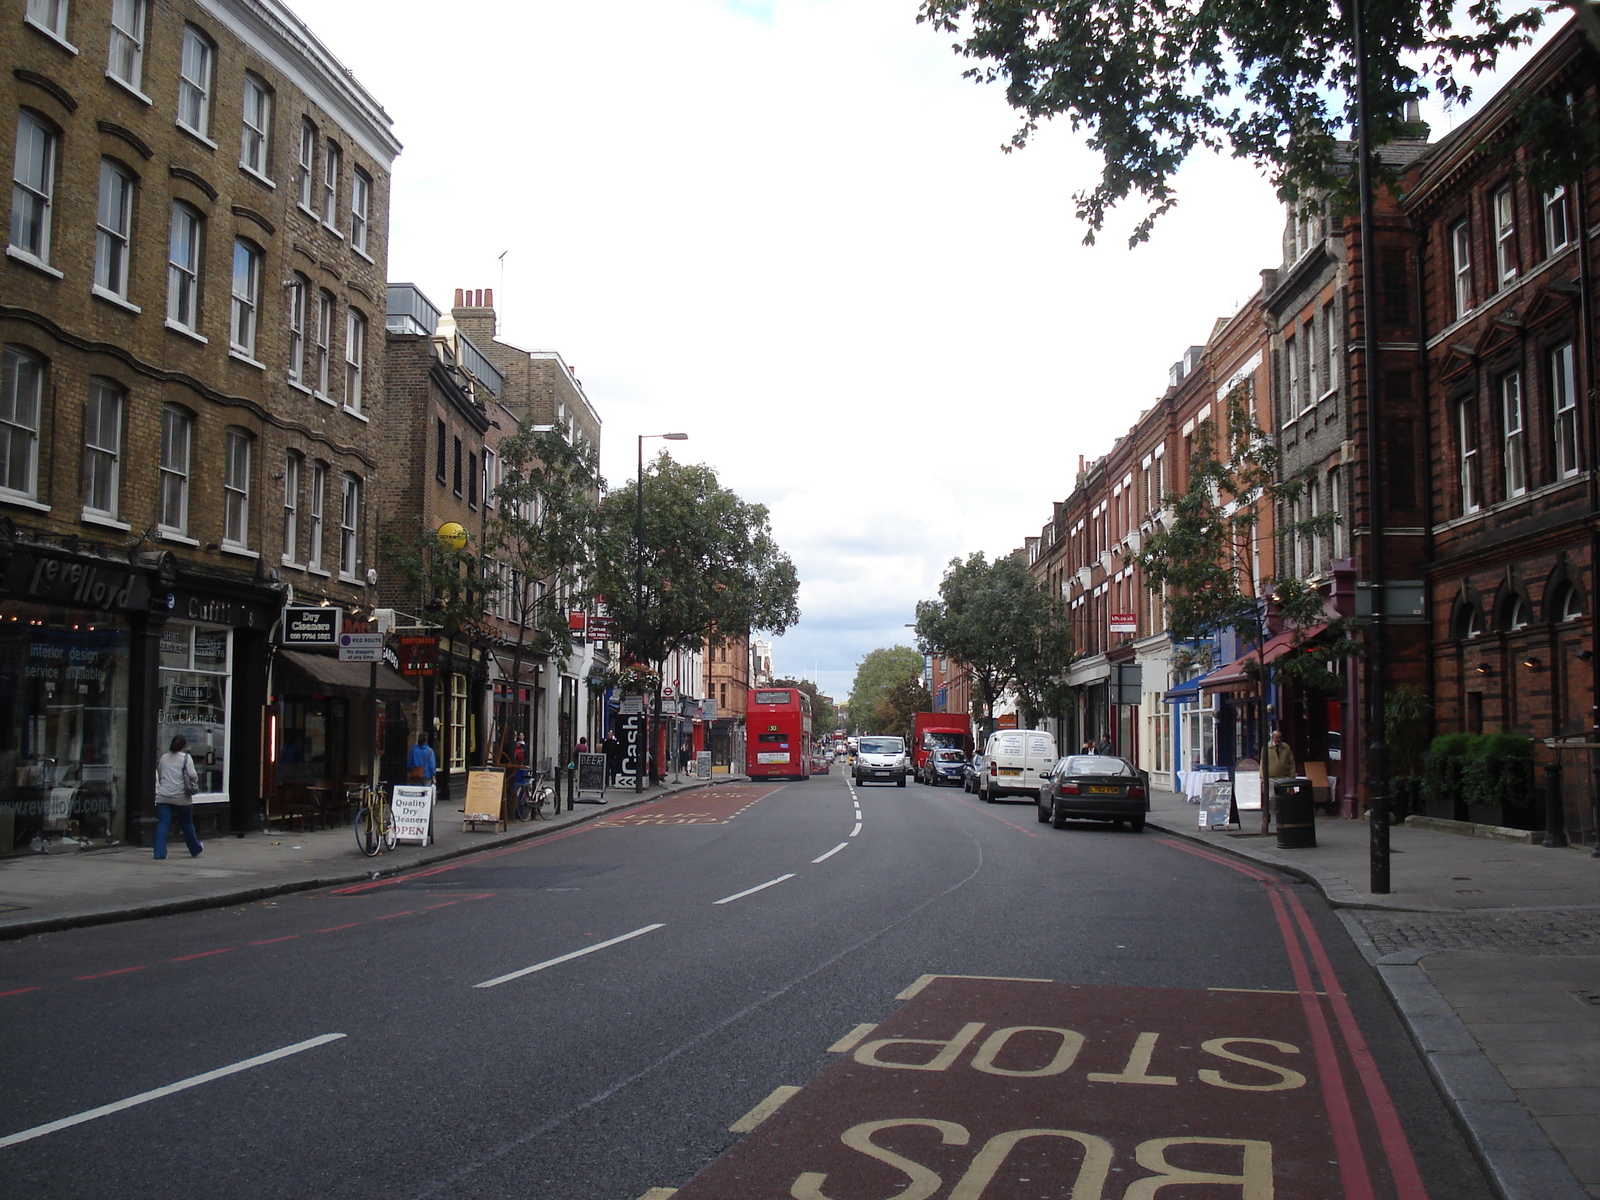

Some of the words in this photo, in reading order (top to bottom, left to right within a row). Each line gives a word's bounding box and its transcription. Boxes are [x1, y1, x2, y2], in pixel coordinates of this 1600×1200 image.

[187, 597, 254, 627] Cufflis
[302, 612, 320, 623] Dry
[291, 621, 331, 631] Cleaners
[163, 630, 180, 642] SHIRT
[159, 641, 183, 653] SERVICE
[30, 645, 64, 659] interior
[69, 647, 98, 664] design
[25, 664, 59, 679] service
[65, 666, 103, 680] available
[175, 685, 203, 697] Cufflinks
[158, 708, 176, 727] Dry
[179, 709, 217, 725] Cleaners
[581, 756, 604, 765] BEER
[396, 799, 427, 808] Quality
[403, 807, 418, 816] Dry
[392, 826, 425, 835] OPEN
[853, 1022, 1307, 1091] STOP
[790, 1117, 1274, 1200] BUS
